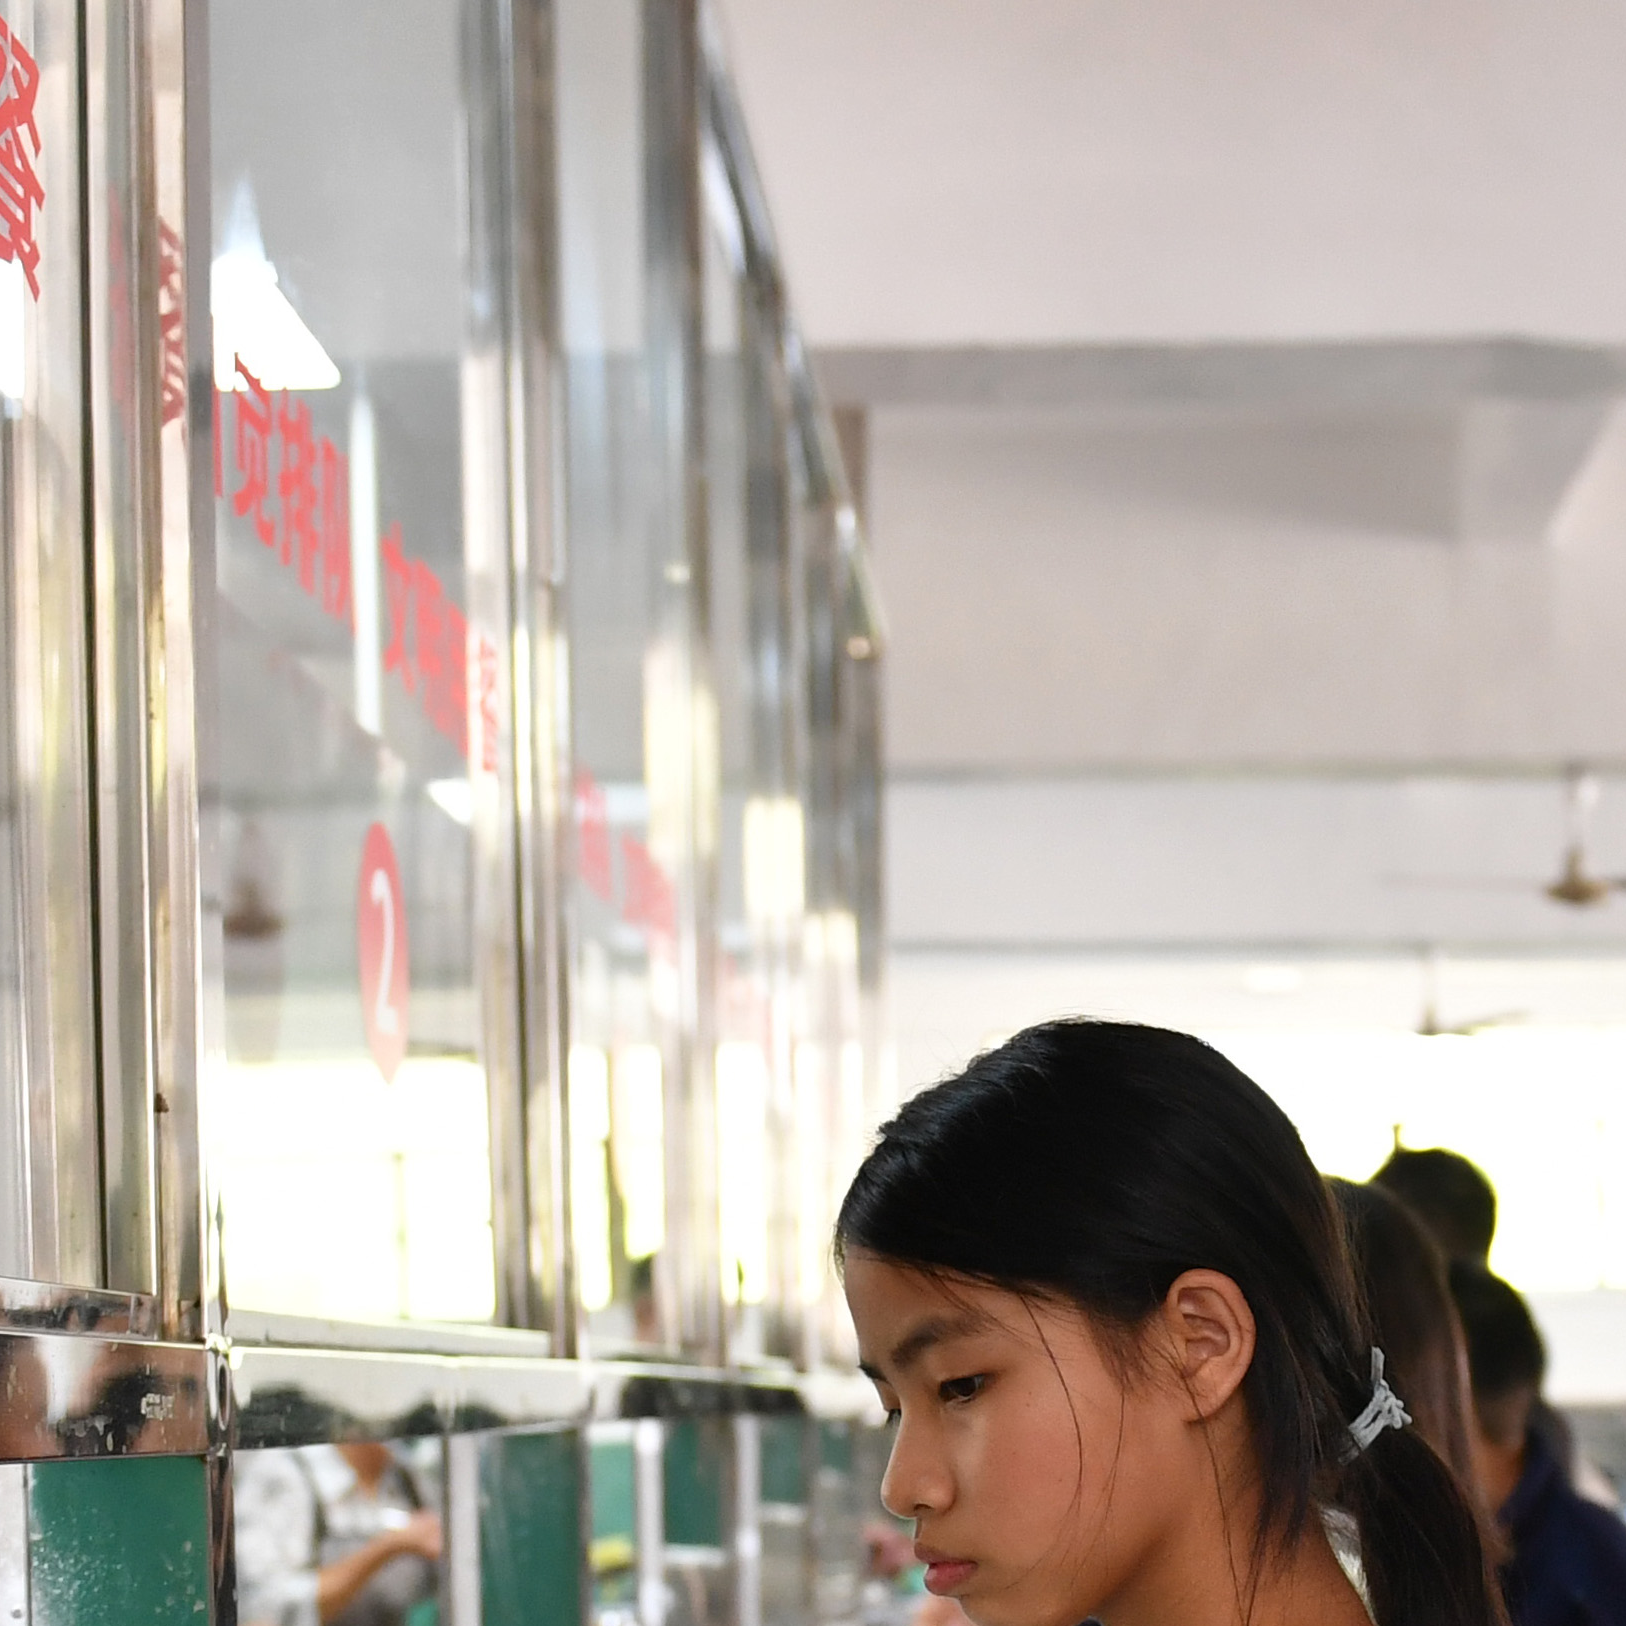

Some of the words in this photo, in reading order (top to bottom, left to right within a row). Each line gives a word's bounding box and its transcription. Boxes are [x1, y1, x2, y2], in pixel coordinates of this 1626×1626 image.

[213, 352, 358, 640] 觉排队
[371, 868, 398, 1033] 2
